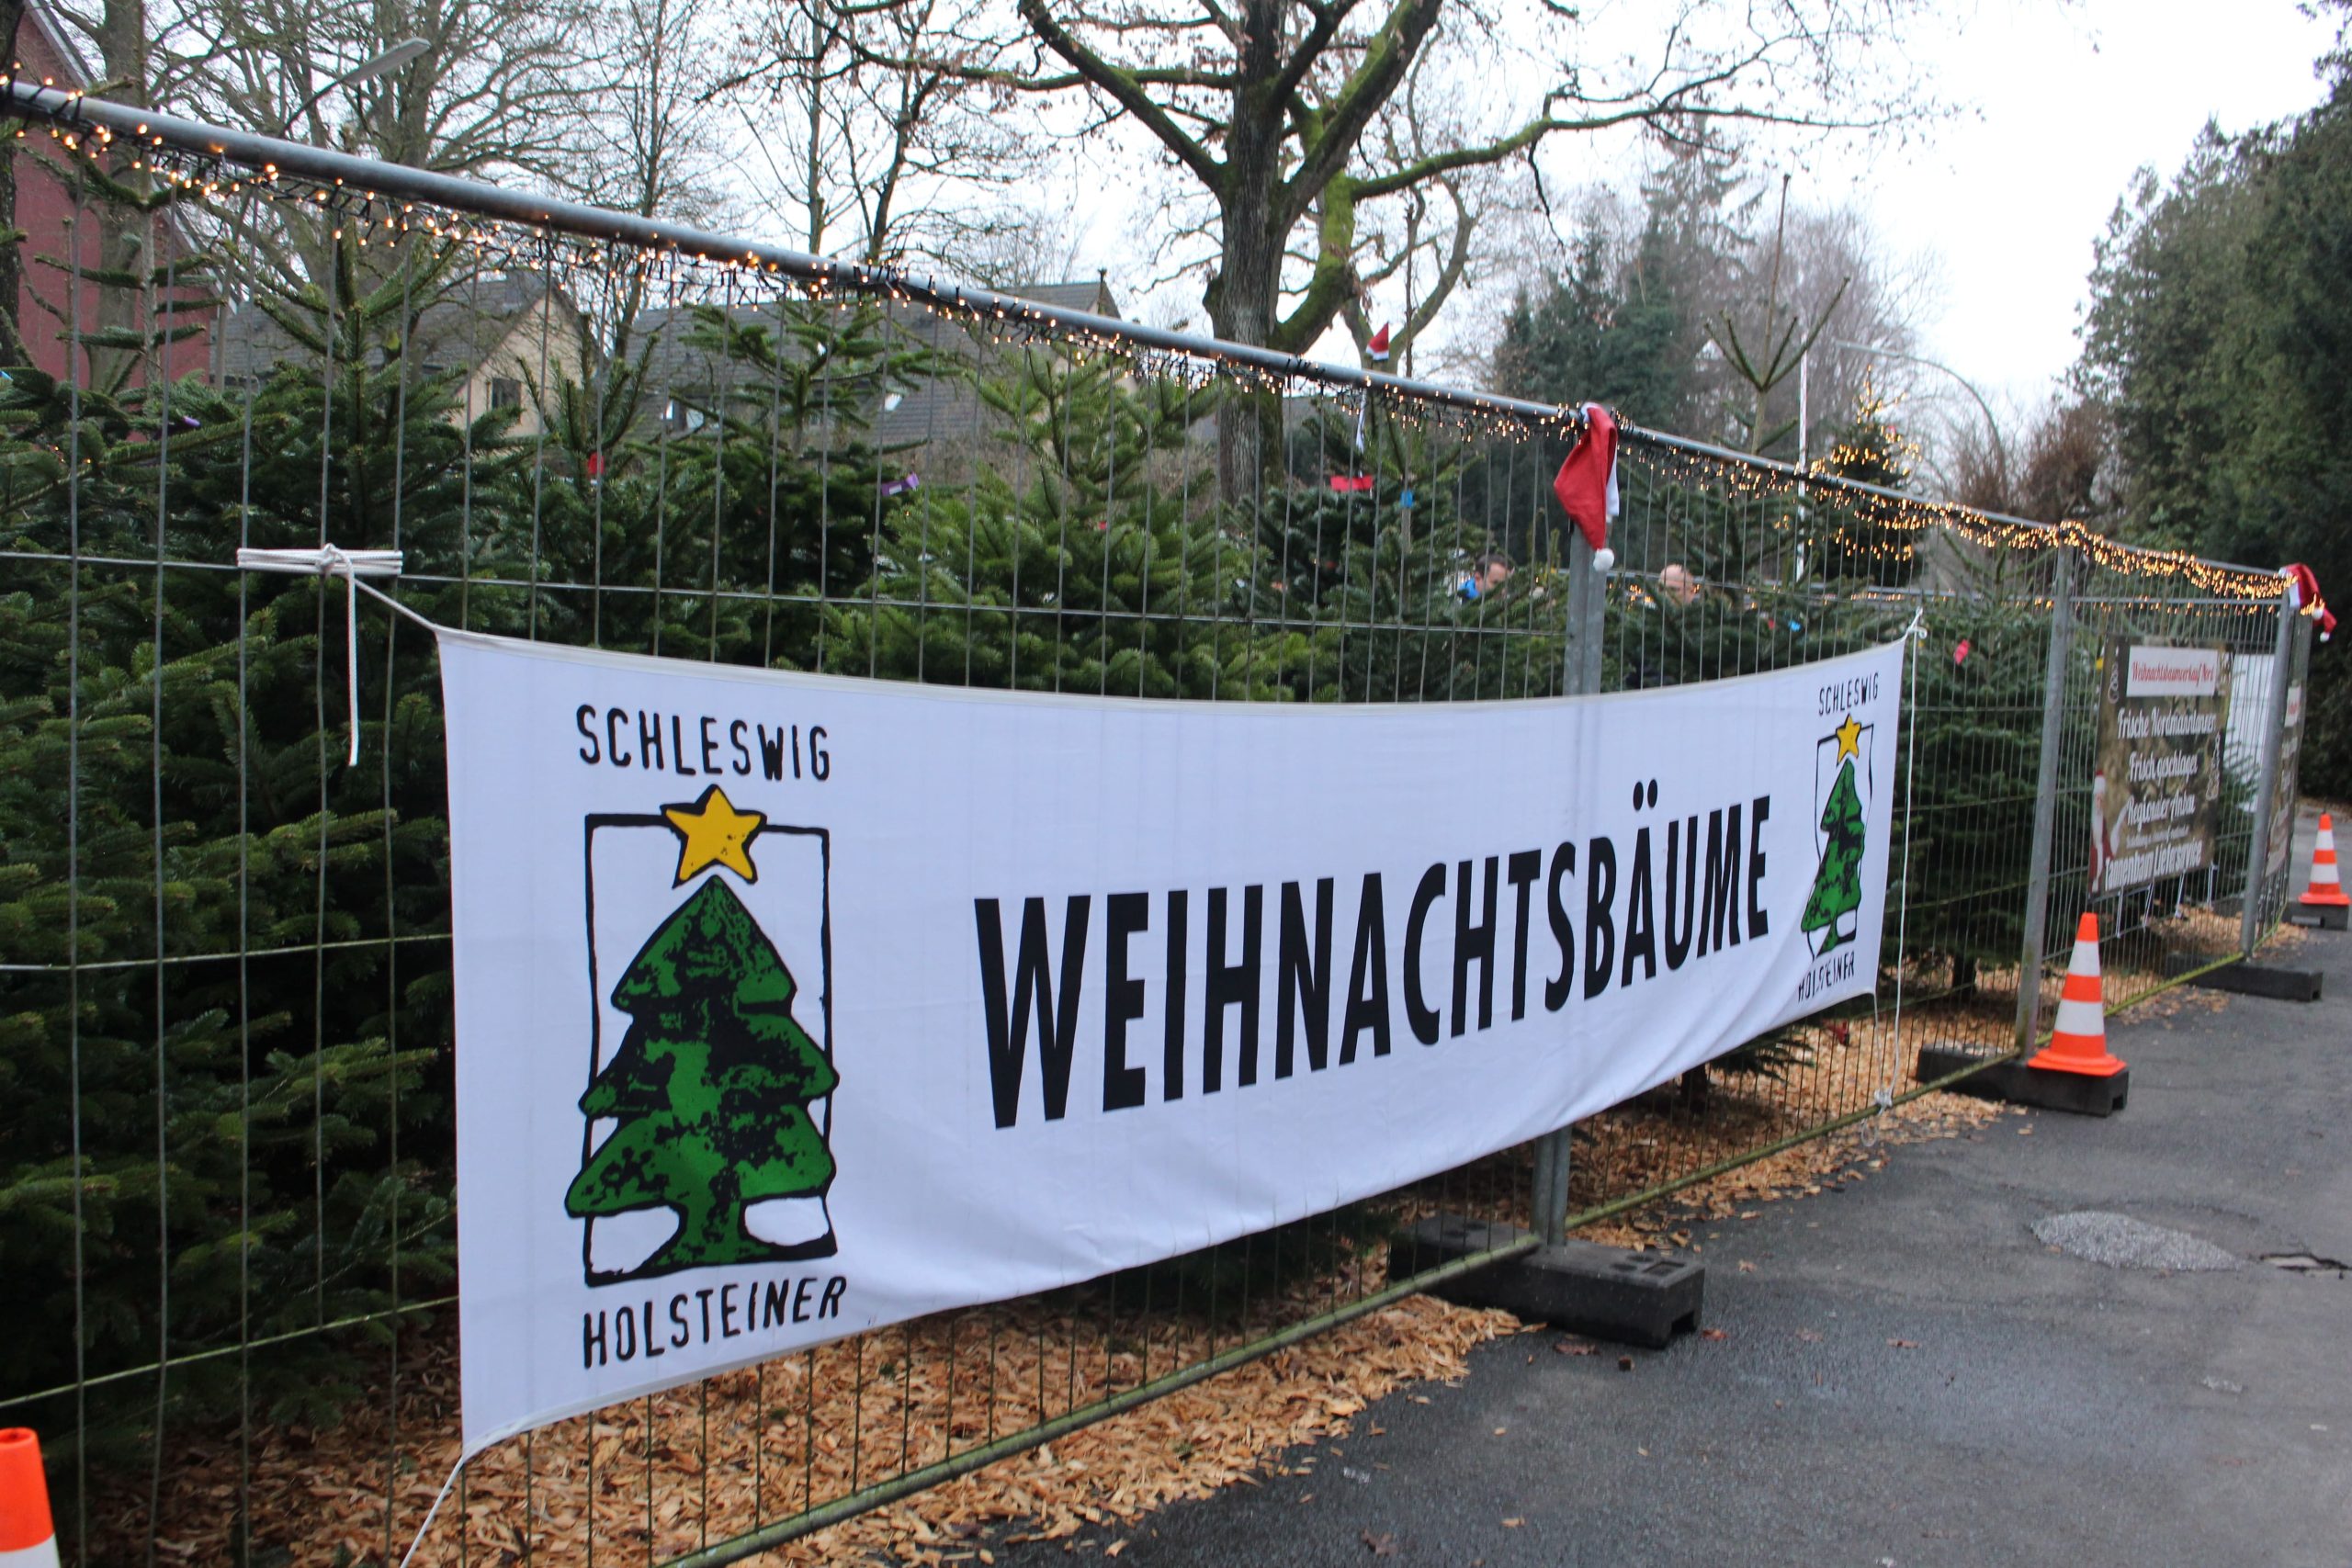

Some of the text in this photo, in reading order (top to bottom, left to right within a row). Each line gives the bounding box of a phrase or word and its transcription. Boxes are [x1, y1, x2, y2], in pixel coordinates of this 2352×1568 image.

[1819, 672, 1879, 716] SCHLESWIG
[2117, 707, 2149, 739] Frische
[576, 705, 830, 781] SCHLESWIG
[2130, 751, 2156, 783] Frisch
[974, 779, 1771, 1131] WEIHNACHTSBÄUME
[583, 1276, 847, 1369] HOLSTEINER
